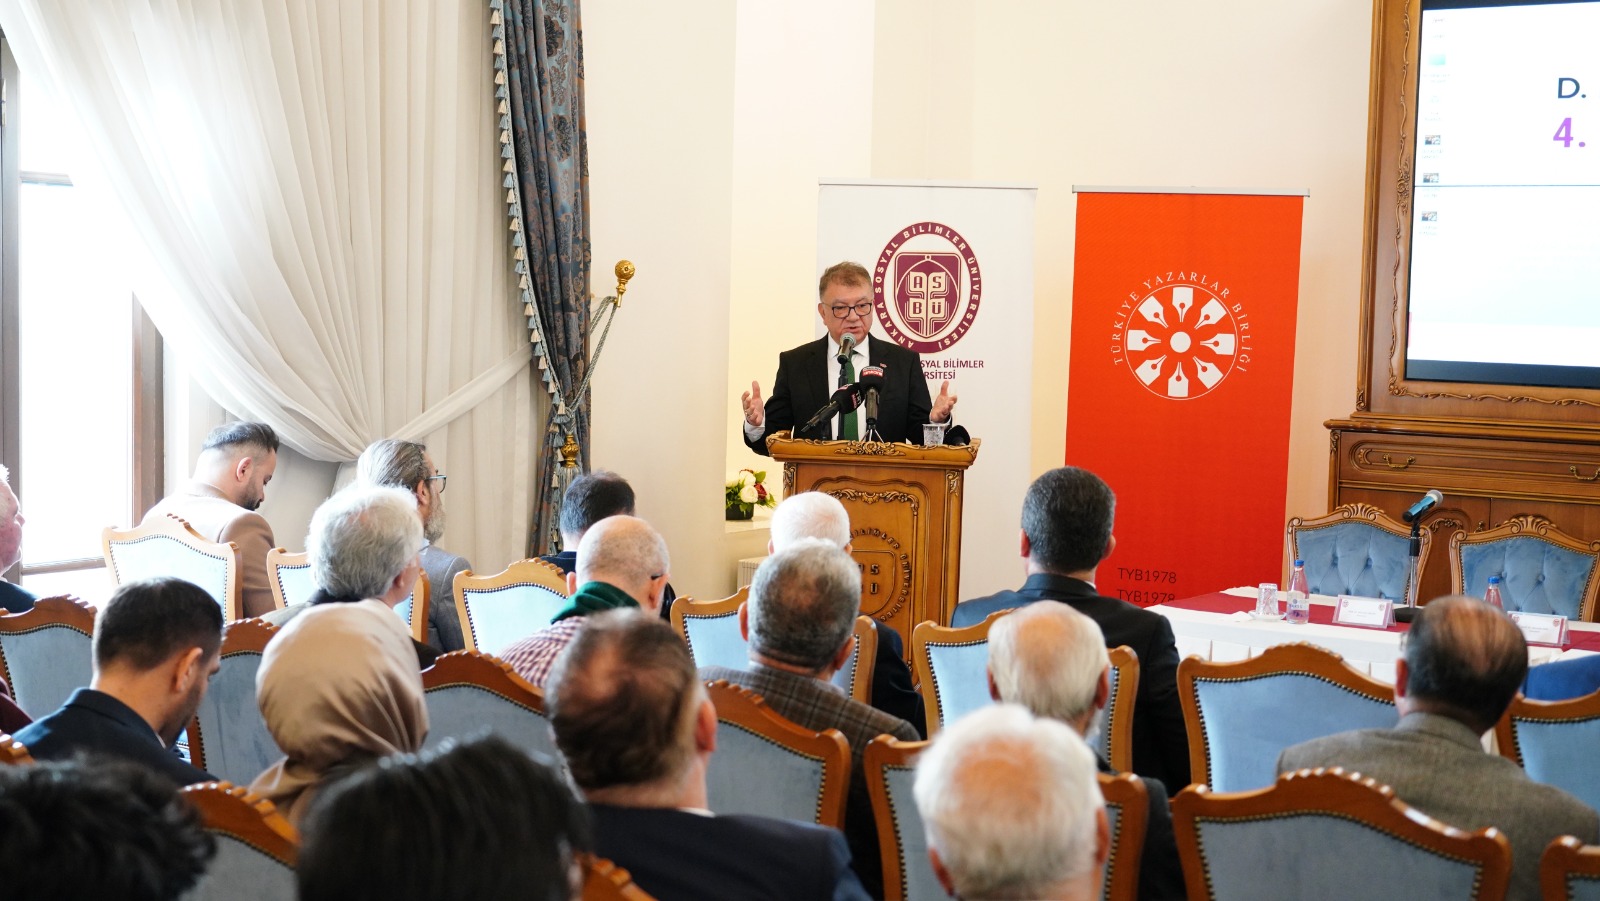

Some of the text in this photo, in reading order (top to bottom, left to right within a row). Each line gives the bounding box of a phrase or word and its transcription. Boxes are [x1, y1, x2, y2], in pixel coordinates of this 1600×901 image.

[1557, 77, 1587, 99] D.
[1553, 117, 1586, 148] 4.
[874, 222, 980, 351] ANKARA SOSYAL BİLİMLER ÜNİVERSİTESİ
[1110, 271, 1253, 372] TÜRKİYE YAZARLAR BİRLİĞİ
[920, 358, 984, 368] SYAL BİLİMLER
[923, 370, 956, 380] RSİTESİ
[1117, 567, 1177, 584] TYB1978
